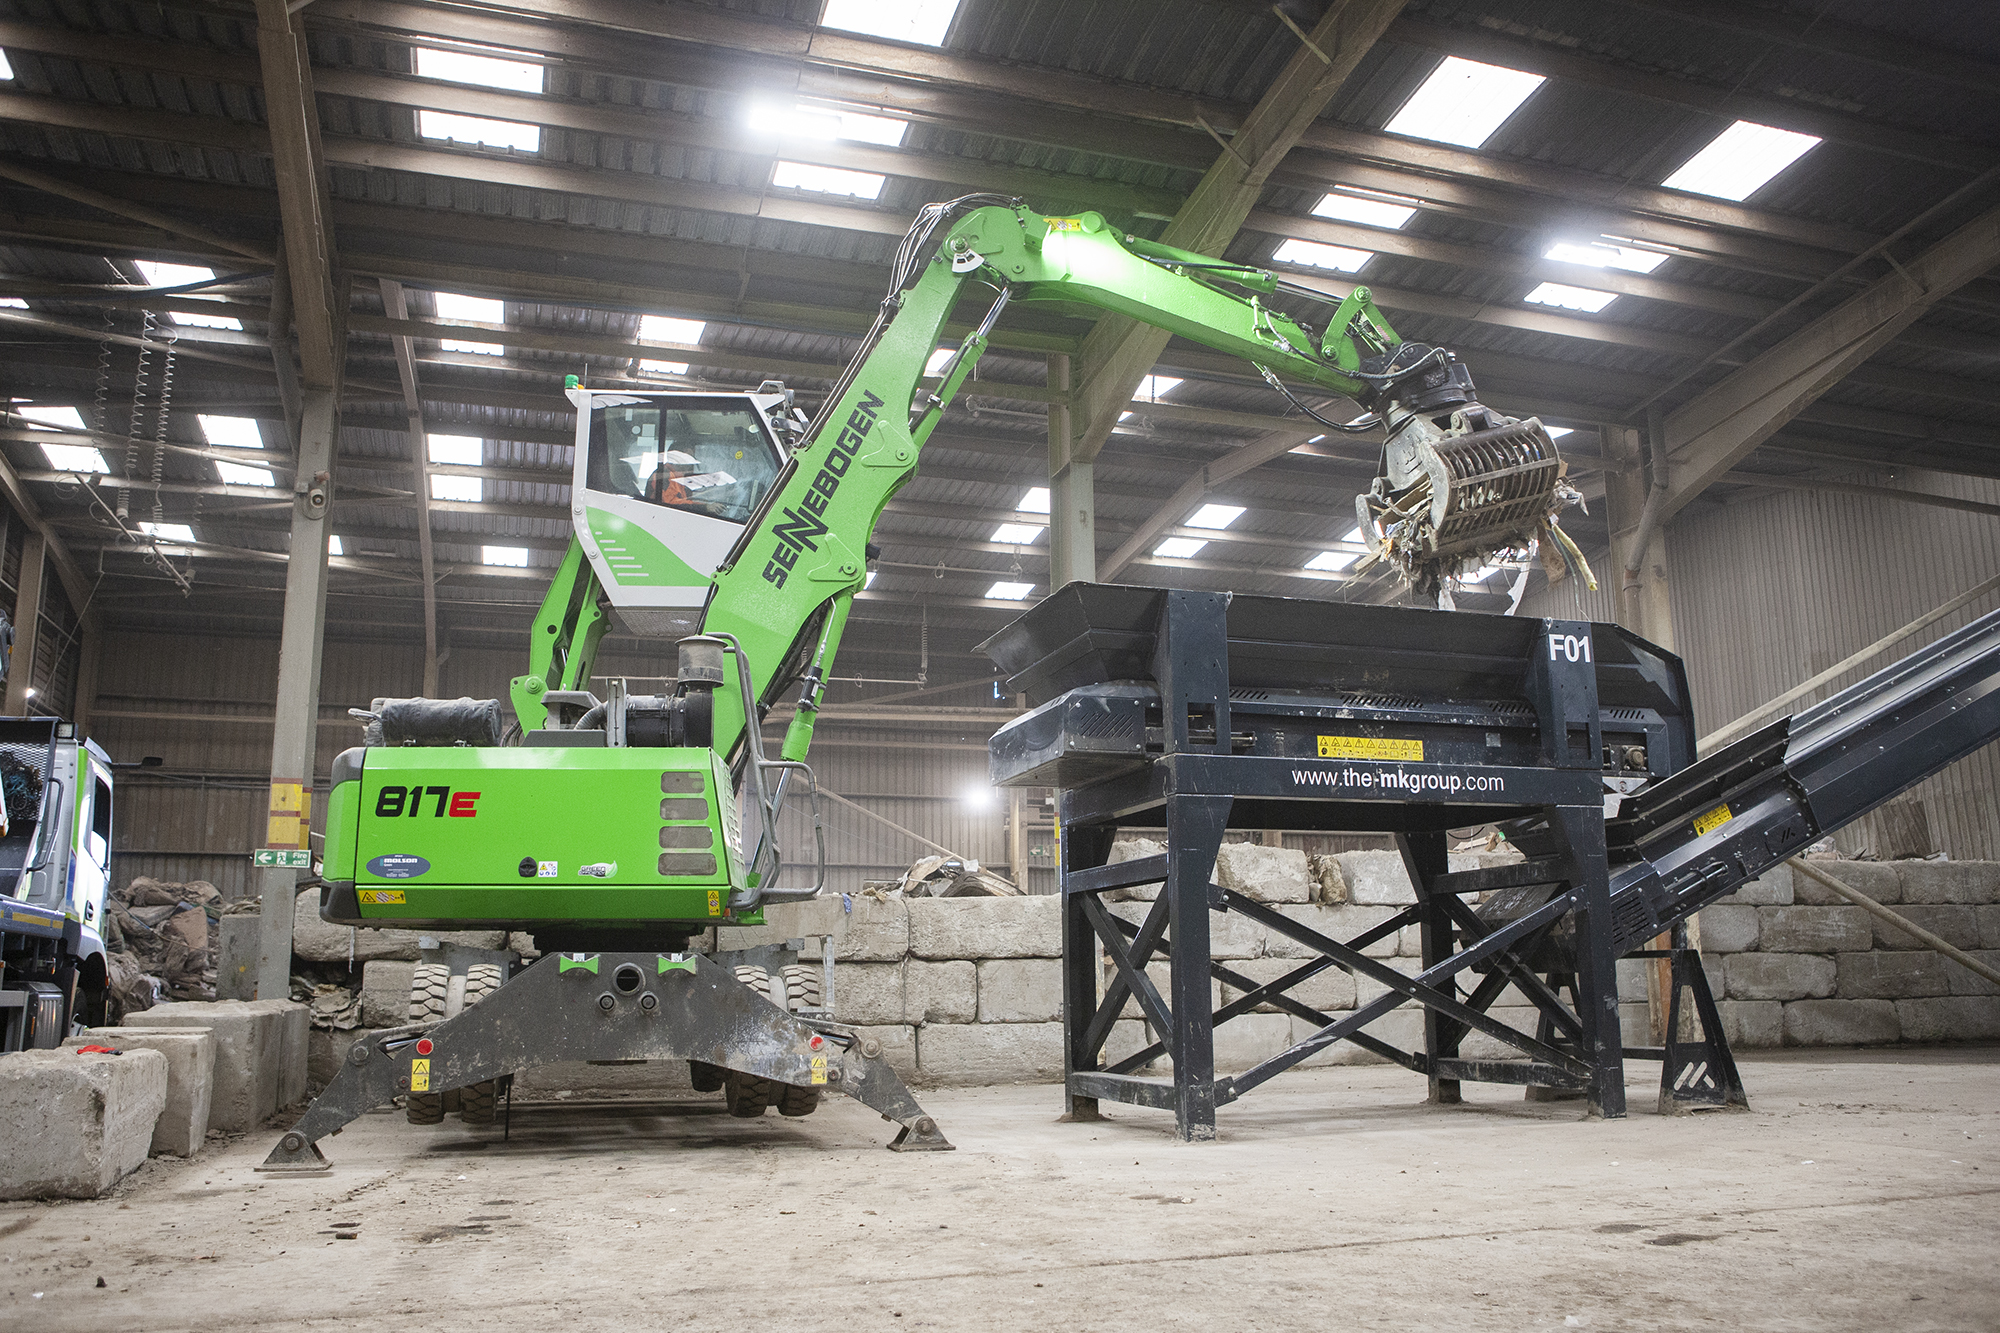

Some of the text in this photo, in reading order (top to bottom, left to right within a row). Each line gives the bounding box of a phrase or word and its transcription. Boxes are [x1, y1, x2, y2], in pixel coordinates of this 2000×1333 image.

[762, 389, 885, 590] SENNEBOGEN
[1549, 634, 1591, 663] F01
[1291, 767, 1505, 794] www.the-mkgroup.com
[375, 786, 481, 817] 817E
